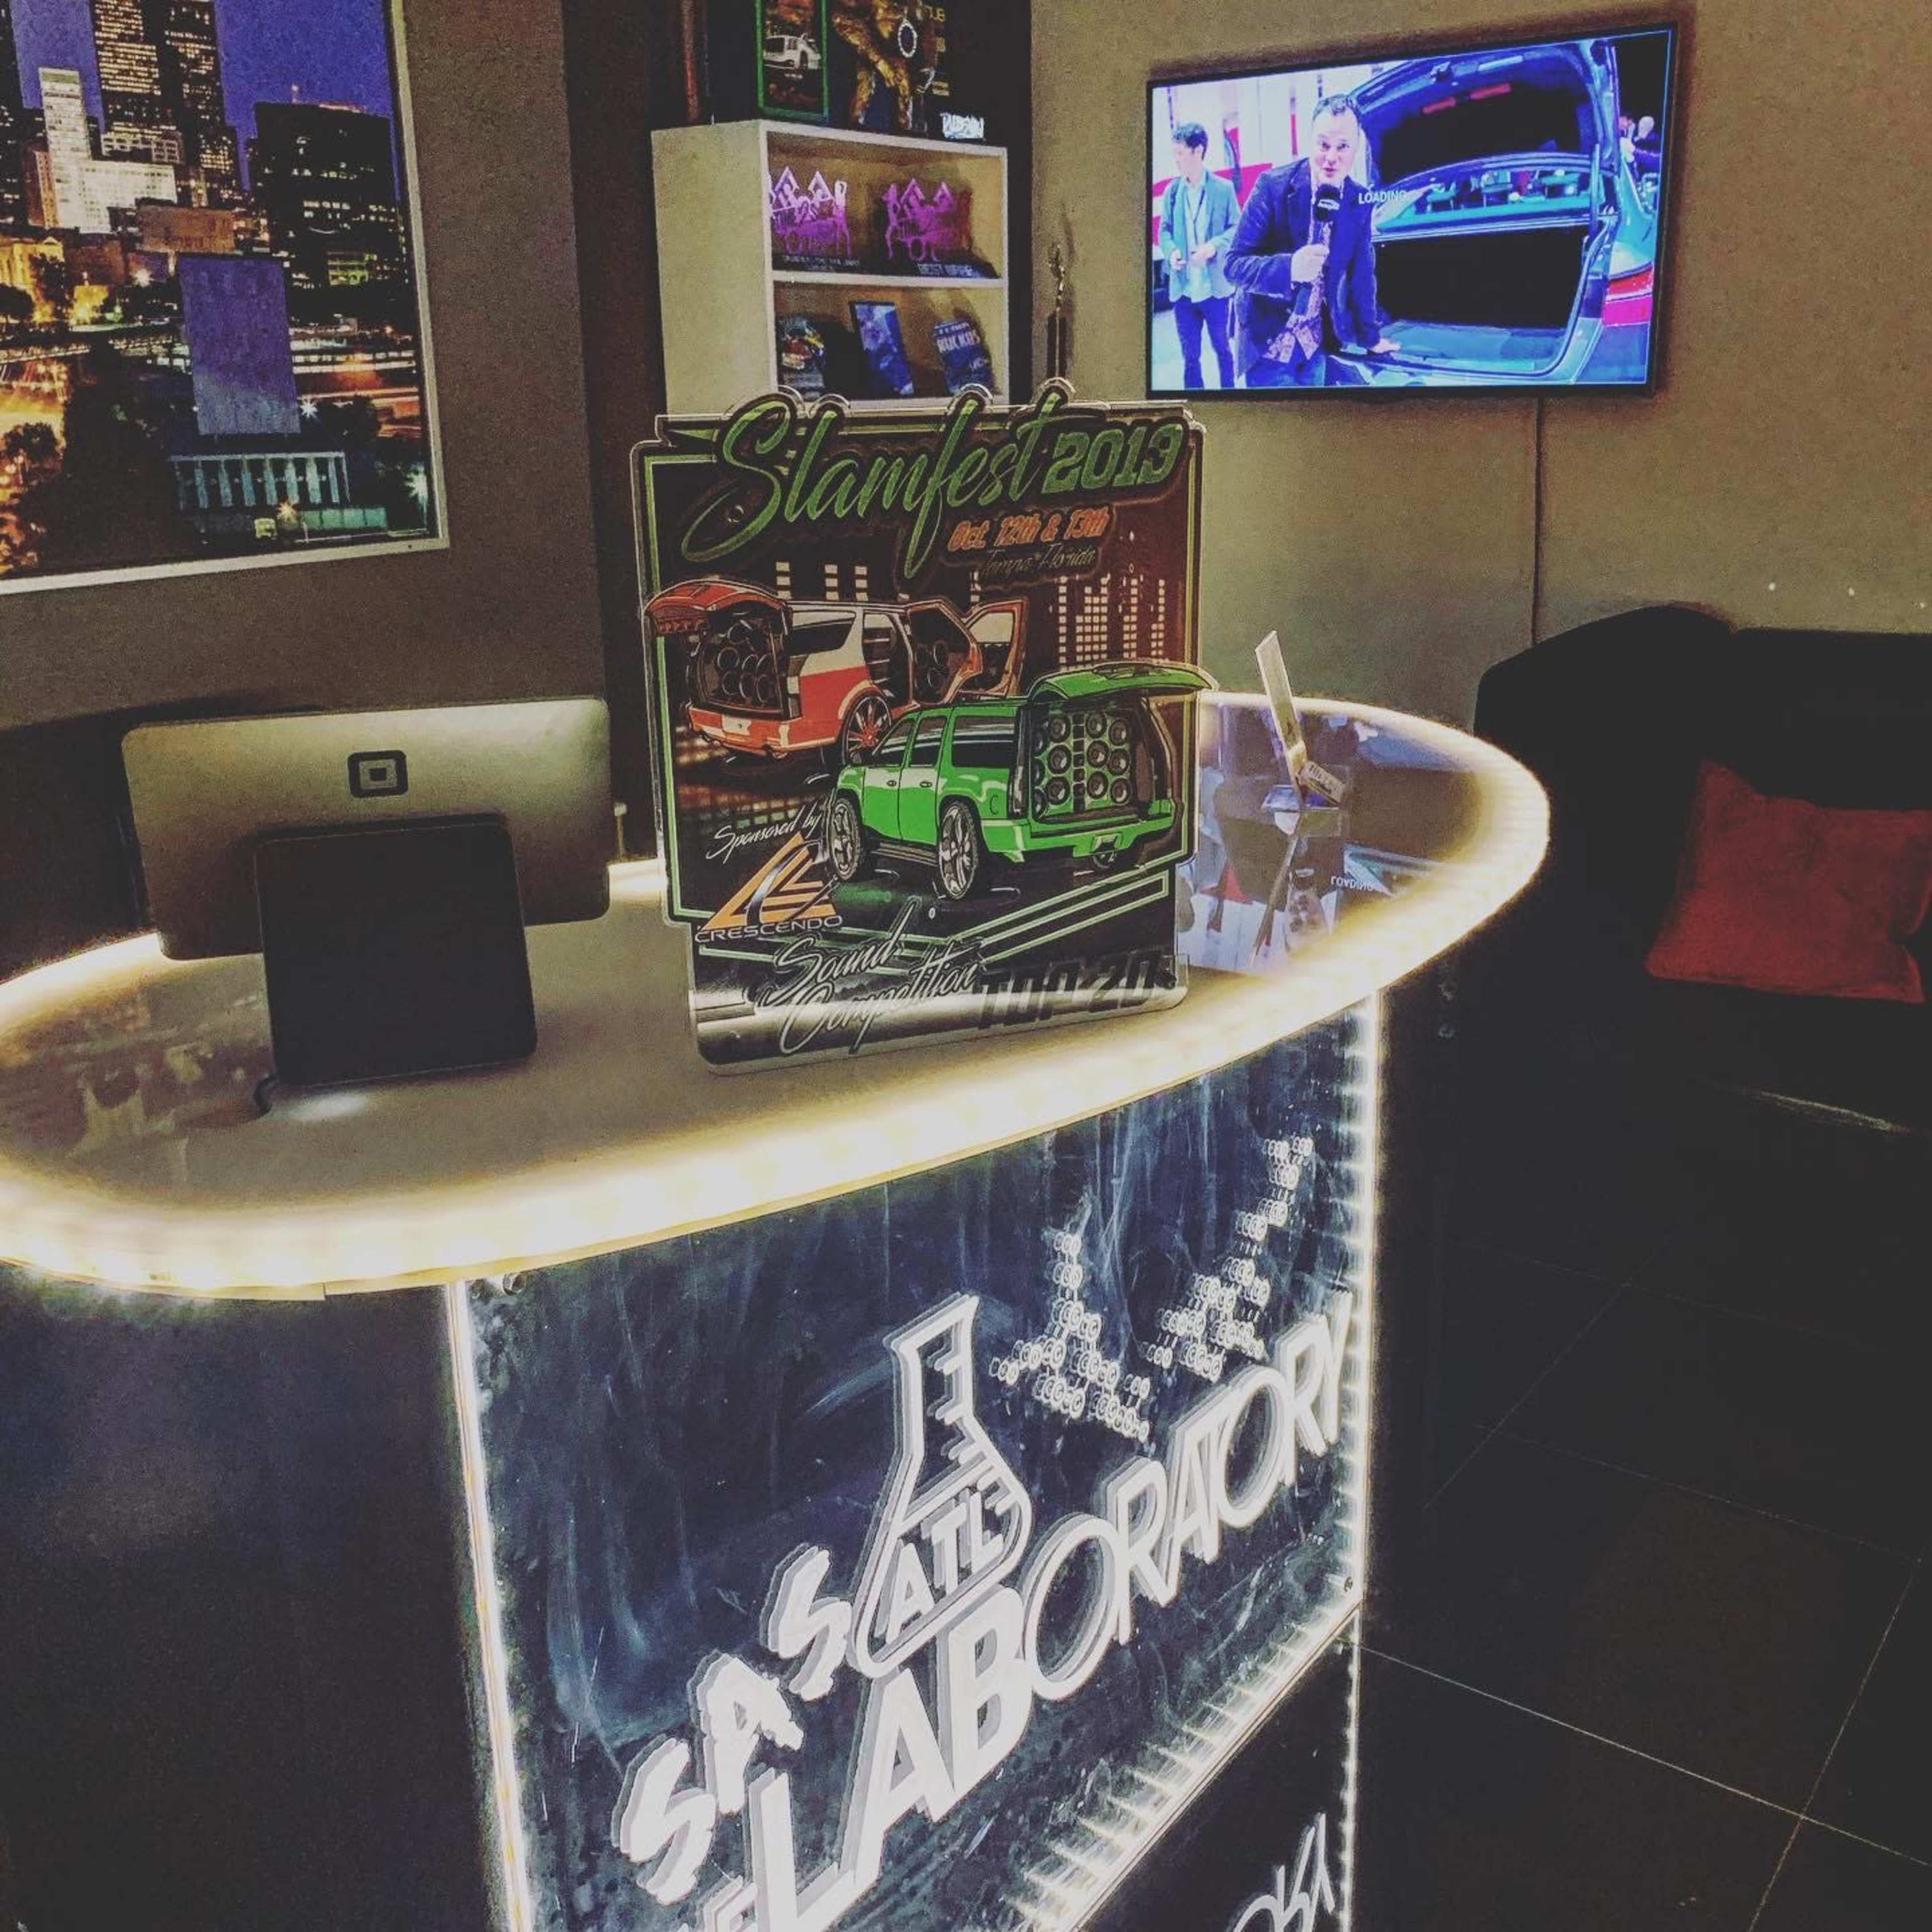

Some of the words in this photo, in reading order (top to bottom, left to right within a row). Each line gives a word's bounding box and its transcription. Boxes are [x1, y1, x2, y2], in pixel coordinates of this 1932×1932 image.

[1358, 189, 1407, 205] LOADING
[681, 392, 1063, 579] Slamfest
[705, 805, 805, 864] Sponsored
[802, 801, 821, 839] by
[694, 915, 843, 943] CRESCENDO
[758, 902, 915, 1006] Sound
[780, 941, 980, 1054] Competition
[749, 1289, 1353, 1932] LABORATORY
[878, 1487, 1004, 1644] ATL
